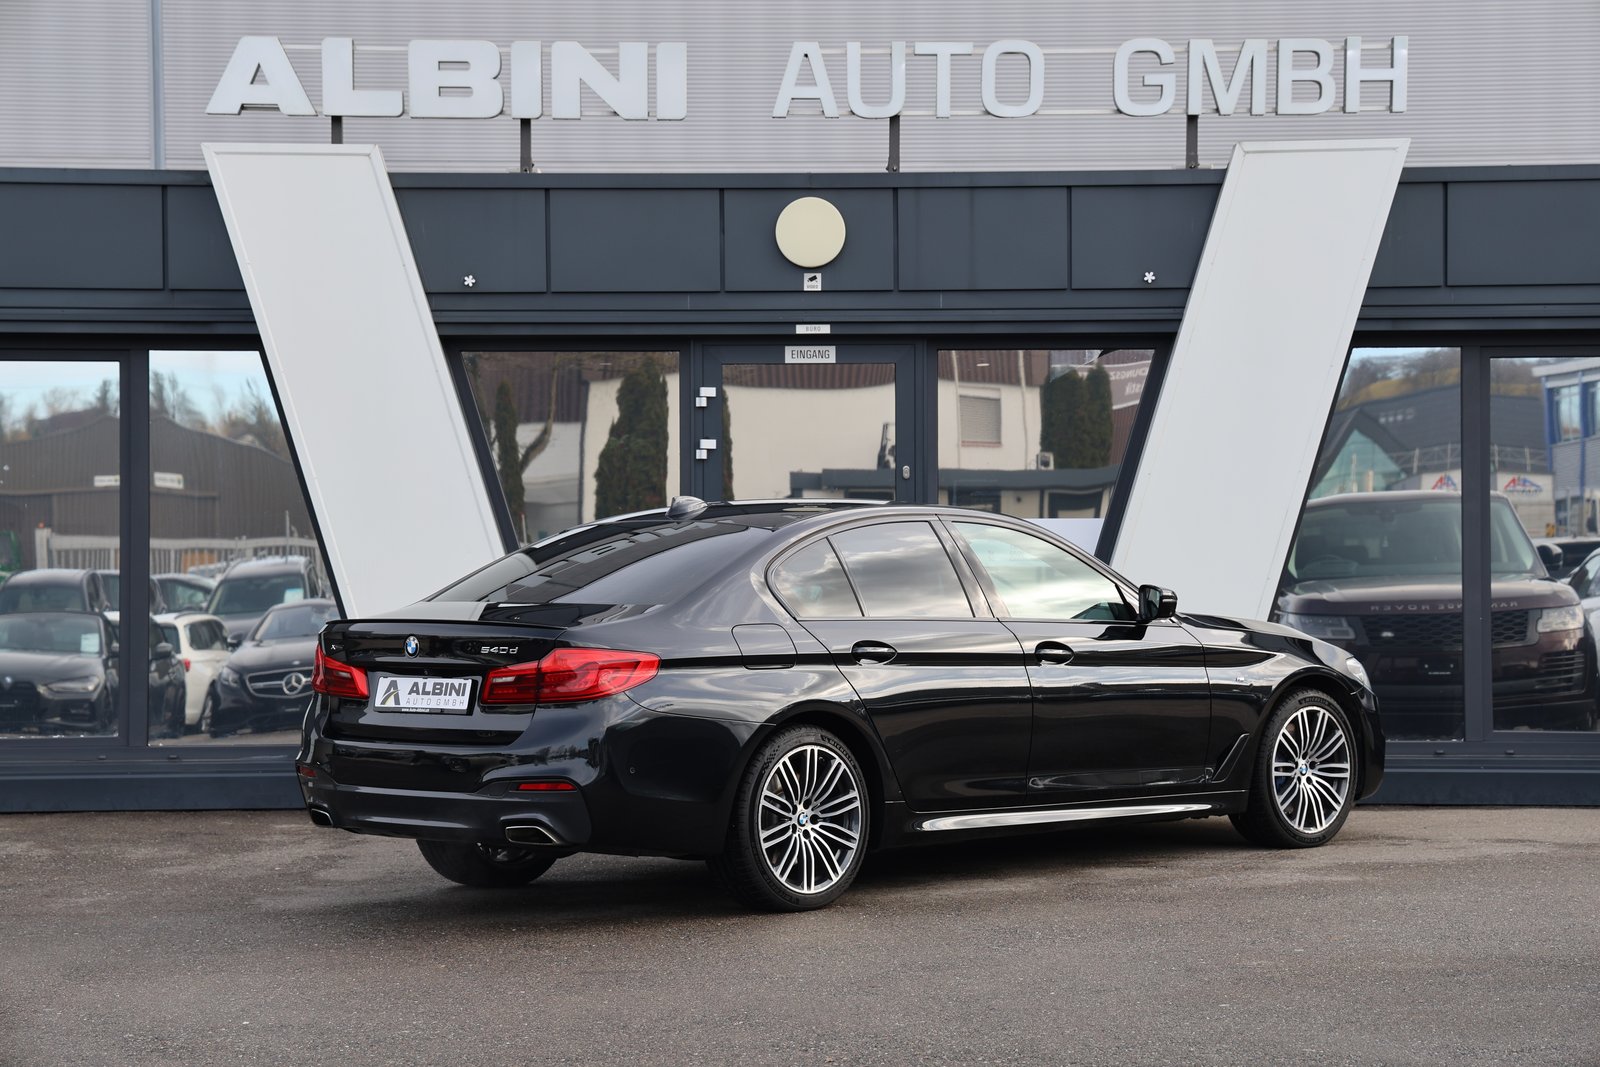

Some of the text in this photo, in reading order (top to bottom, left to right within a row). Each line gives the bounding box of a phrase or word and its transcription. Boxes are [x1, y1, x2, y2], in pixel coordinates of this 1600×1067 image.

[205, 35, 1409, 120] ALBINI AUTO GMBH
[791, 349, 830, 359] EINGANG
[480, 646, 519, 655] 540d
[407, 681, 467, 697] ALBINI
[406, 698, 465, 707] AUTO GMBH
